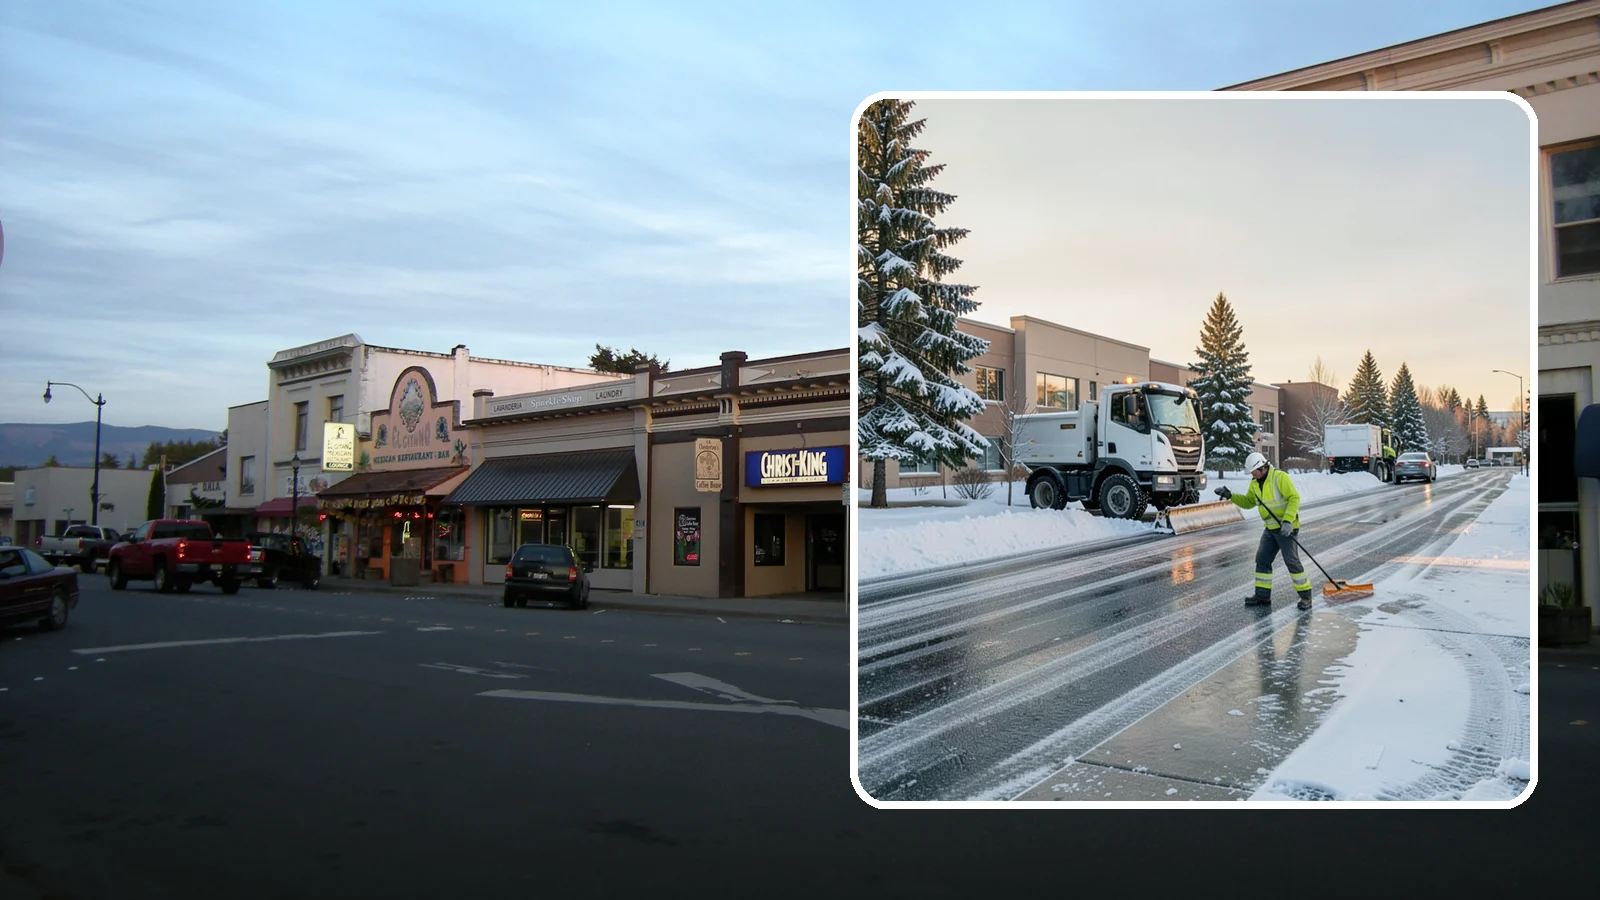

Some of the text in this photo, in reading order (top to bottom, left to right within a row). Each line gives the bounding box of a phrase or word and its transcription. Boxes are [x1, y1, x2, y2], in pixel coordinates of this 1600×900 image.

[494, 389, 624, 413] LAVANDERIA Sparkle Shop LAUNDRY
[373, 454, 396, 464] MEXICAN
[397, 451, 434, 462] RESTAURANT
[438, 449, 450, 459] BAR
[761, 450, 827, 478] CHRIST KING
